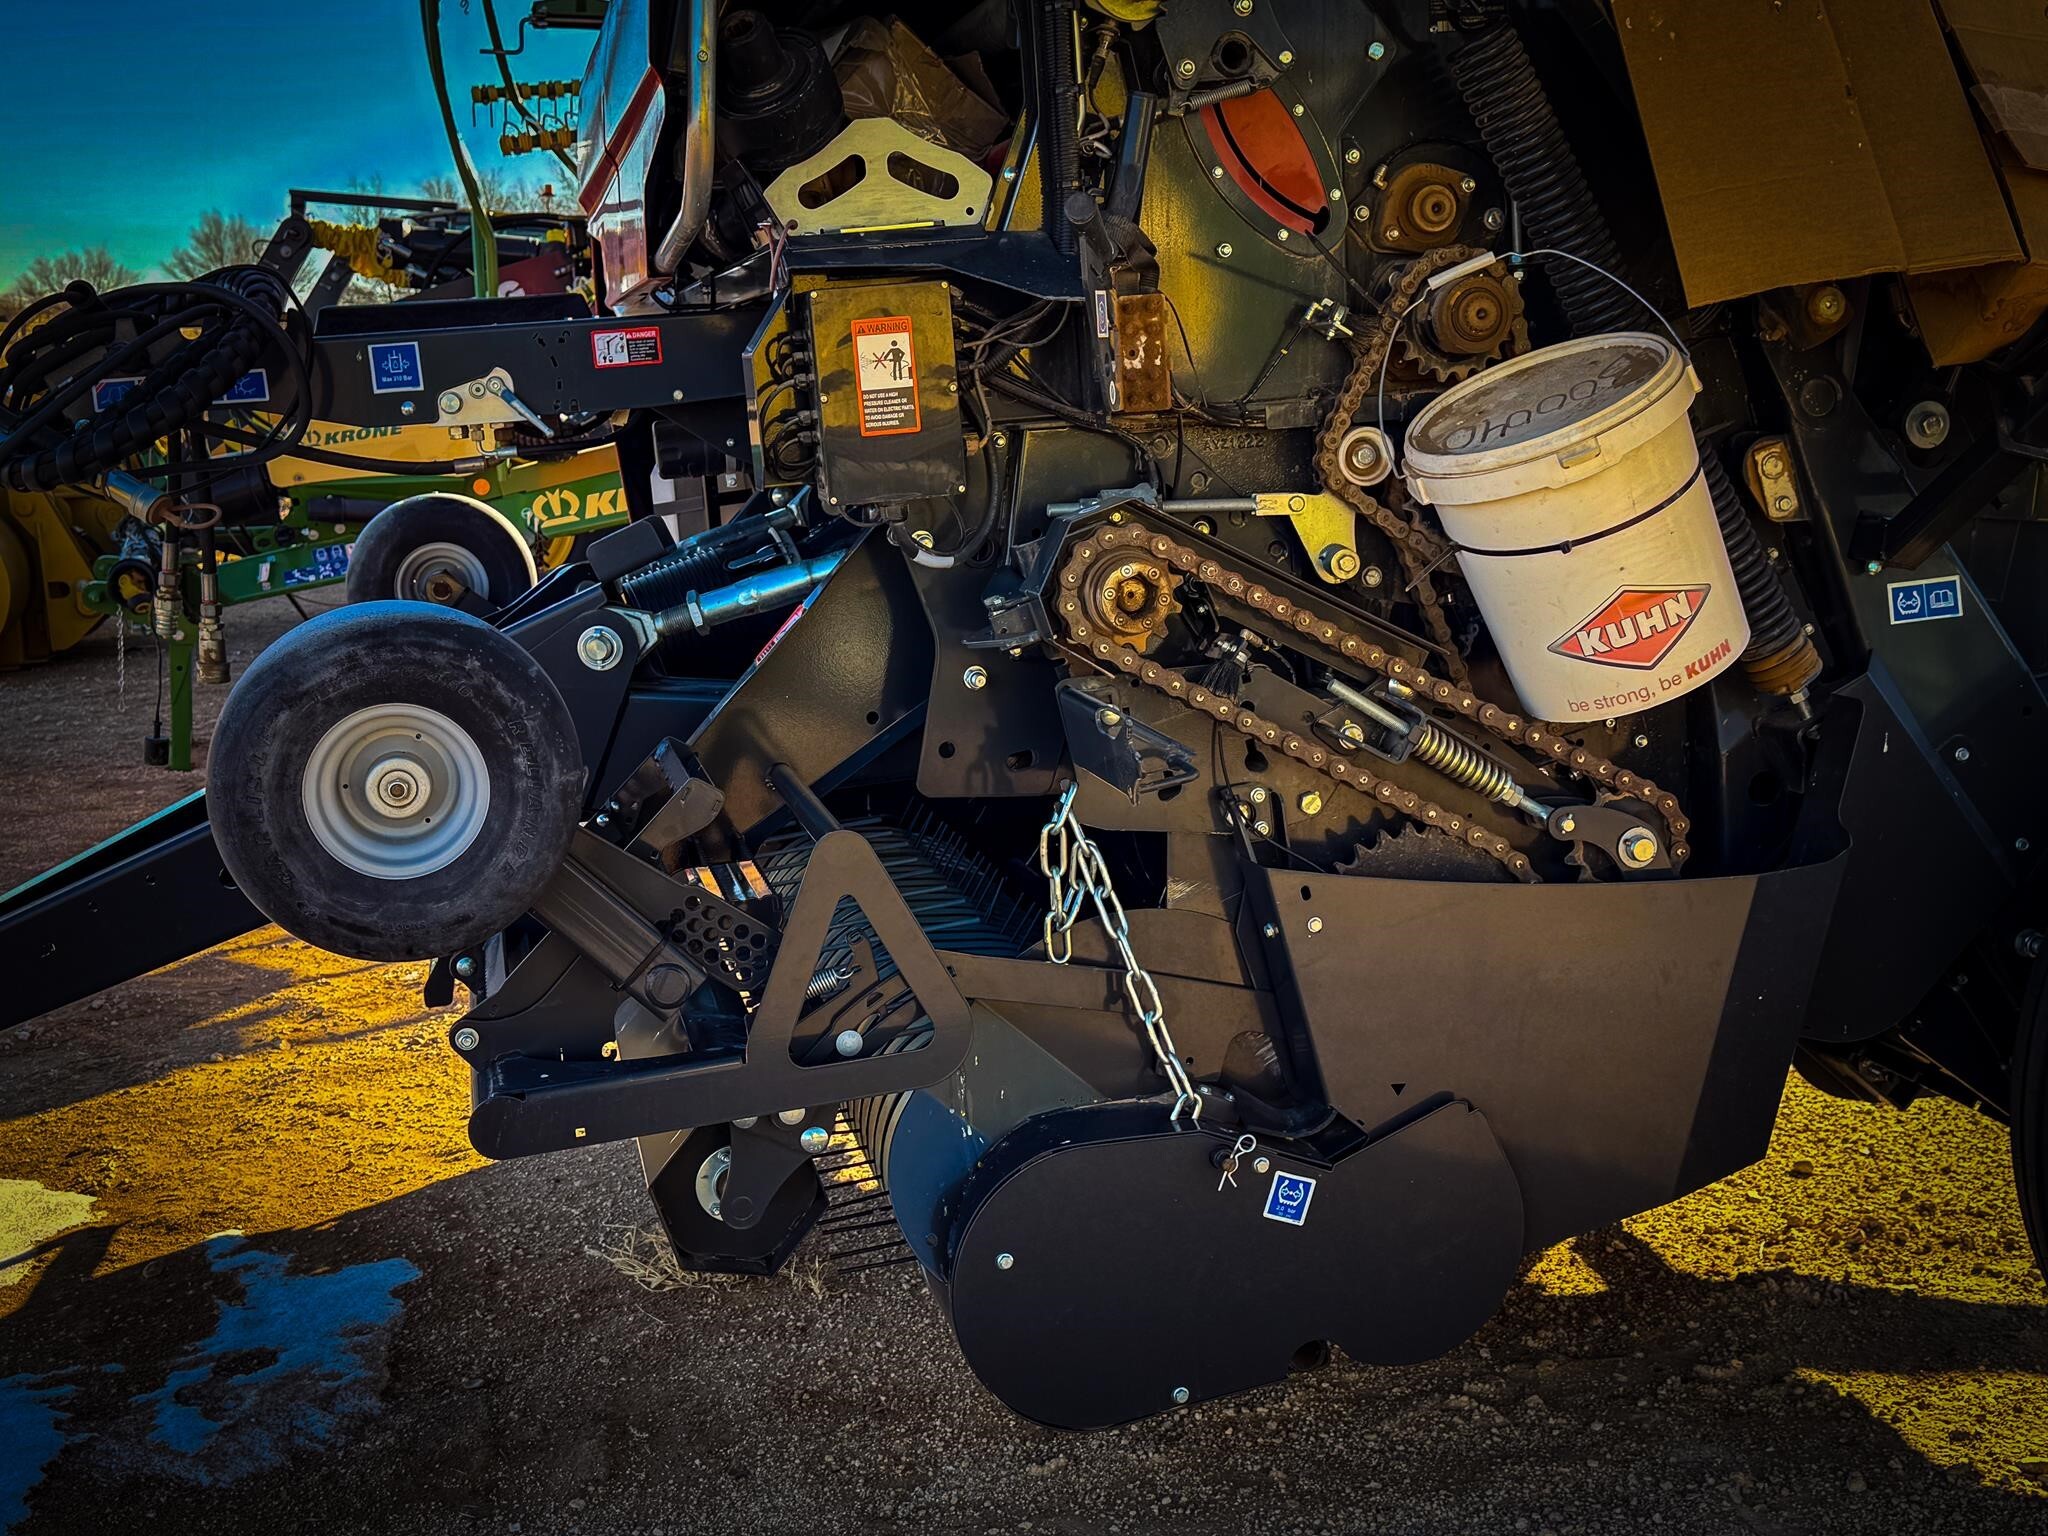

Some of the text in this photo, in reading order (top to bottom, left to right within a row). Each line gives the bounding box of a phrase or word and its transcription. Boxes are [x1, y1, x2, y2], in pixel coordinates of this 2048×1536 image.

[866, 321, 907, 332] WARNING
[403, 374, 413, 382] Bar
[325, 427, 402, 445] KRONE
[1576, 590, 1693, 657] KUHN
[1568, 639, 1732, 713] be strong, be KUHN
